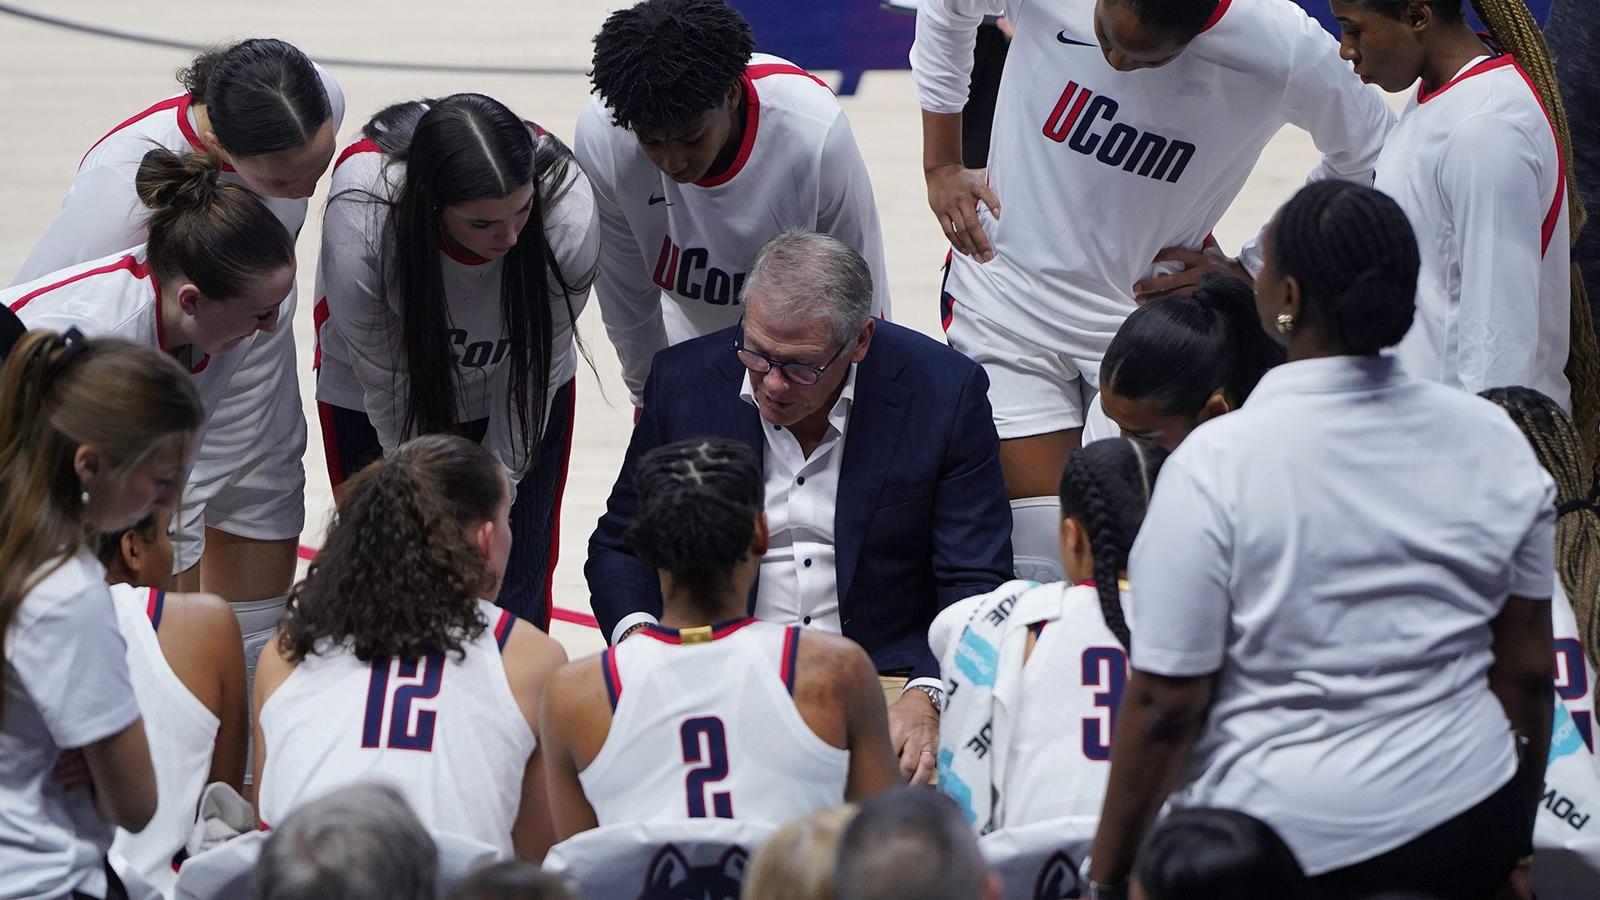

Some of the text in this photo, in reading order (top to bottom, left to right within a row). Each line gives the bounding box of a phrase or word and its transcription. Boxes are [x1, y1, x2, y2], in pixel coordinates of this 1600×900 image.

[1042, 80, 1196, 183] UConn
[652, 234, 748, 306] UCo
[361, 654, 446, 752] 12
[1081, 646, 1128, 761] 3
[680, 716, 734, 819] 2
